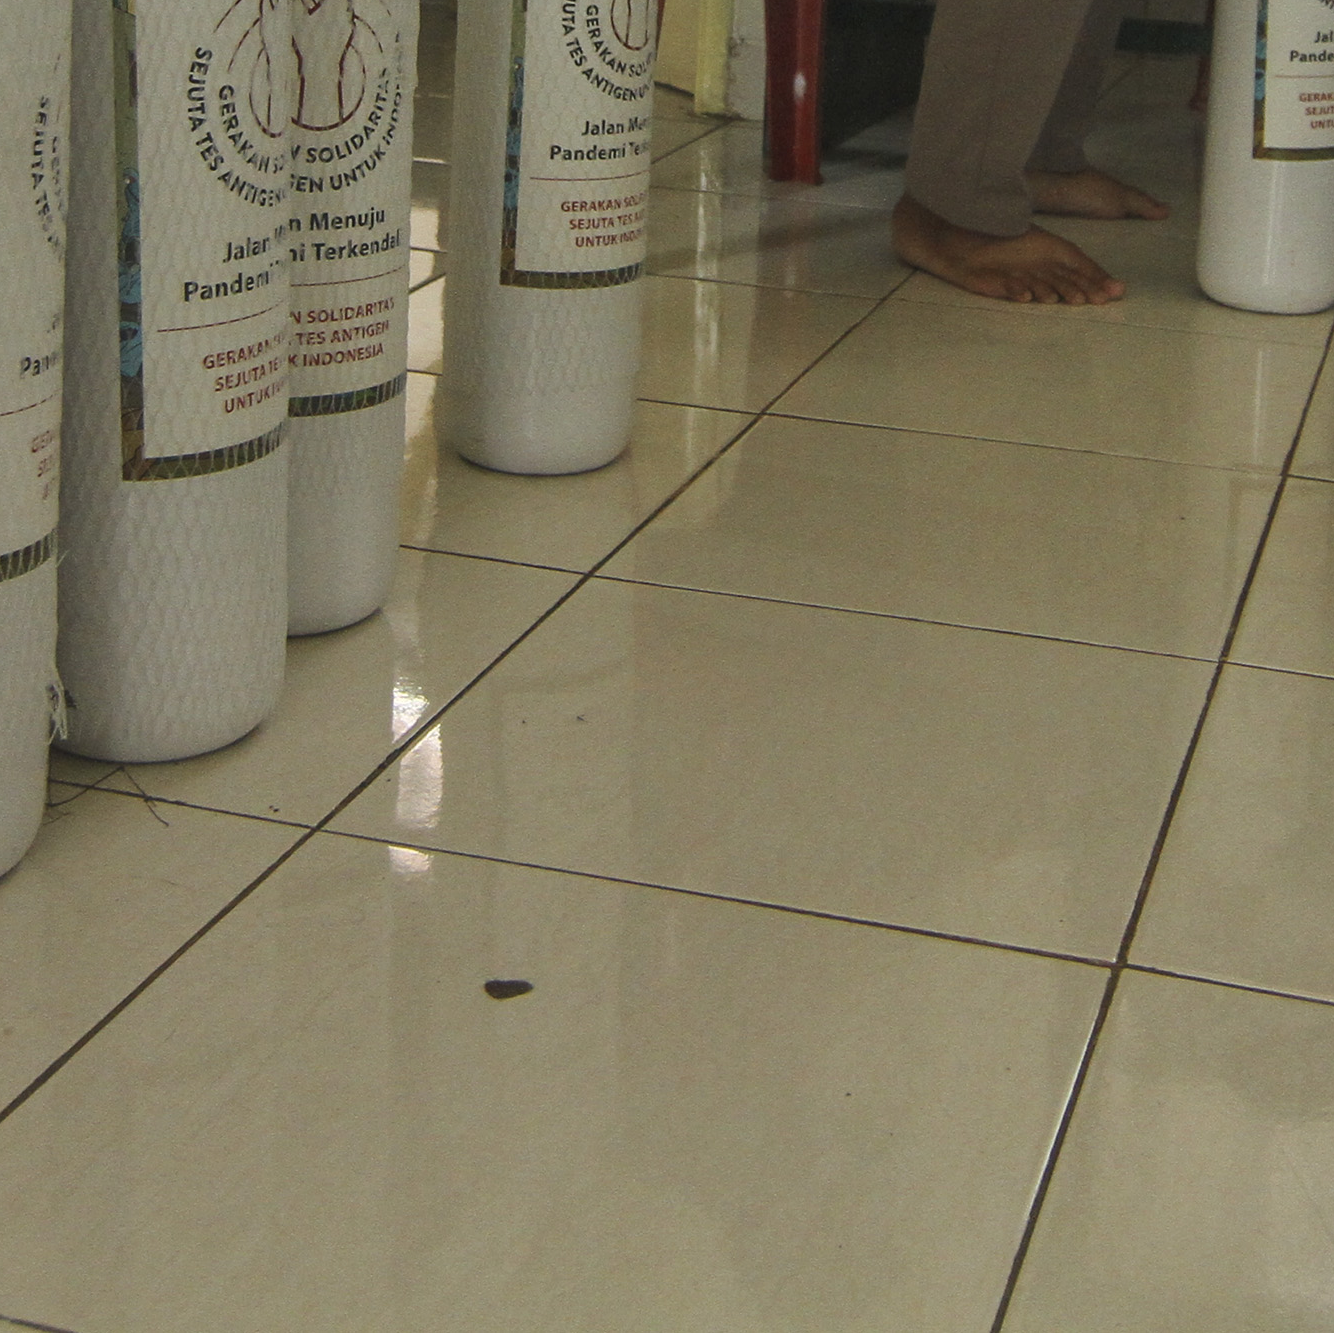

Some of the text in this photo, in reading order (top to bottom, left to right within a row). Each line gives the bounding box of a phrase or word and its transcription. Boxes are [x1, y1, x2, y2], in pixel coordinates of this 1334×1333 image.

[586, 4, 626, 75] GERAKAN
[566, 37, 588, 67] TES
[582, 68, 637, 101] ANTIGEN
[187, 47, 212, 132] SEJUTA
[219, 84, 270, 174] GERAKAN
[581, 120, 624, 137] Jalan
[196, 132, 224, 171] TES
[550, 143, 626, 160] Pandemi
[330, 144, 386, 190] UNTUK
[310, 207, 385, 231] Menuju
[561, 198, 621, 213] GERAKAN
[569, 217, 614, 230] SEJUTA
[575, 234, 618, 248] UNTUK
[307, 297, 394, 324] SOLIDARITAS
[296, 331, 326, 346] TES
[331, 320, 389, 344] ANTIGEN
[303, 342, 384, 366] INDONESIA
[215, 363, 266, 392] SEJUTA
[224, 383, 270, 414] UNTUK
